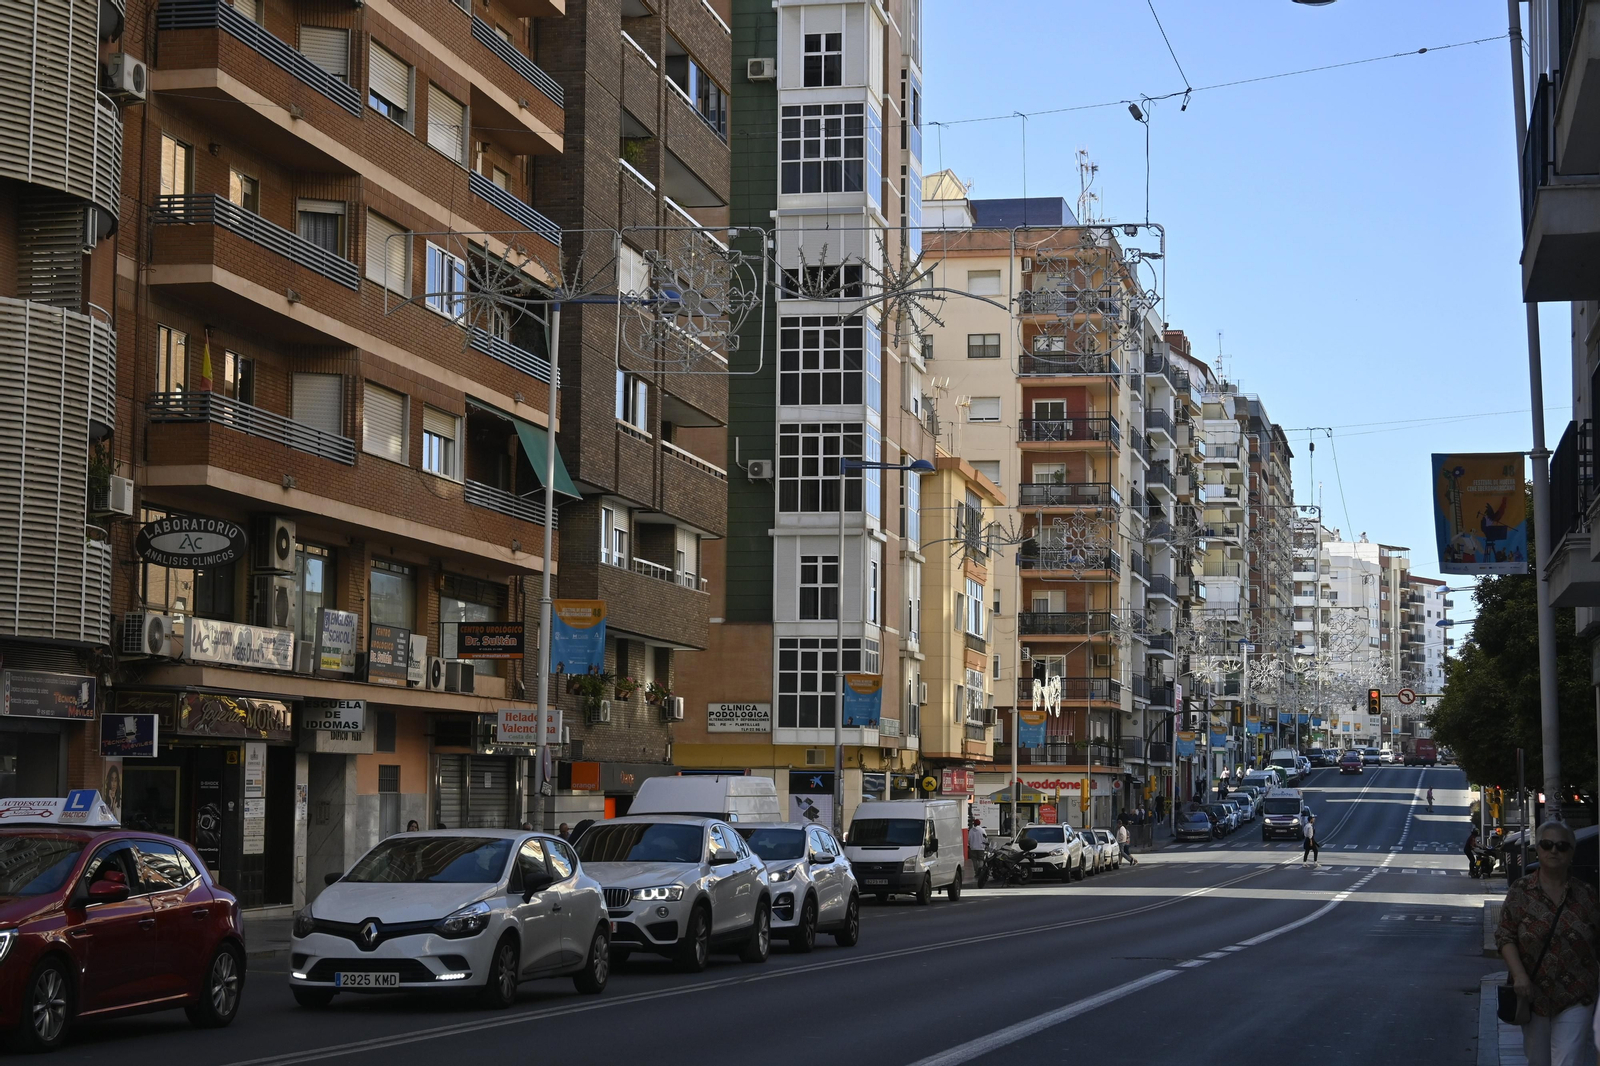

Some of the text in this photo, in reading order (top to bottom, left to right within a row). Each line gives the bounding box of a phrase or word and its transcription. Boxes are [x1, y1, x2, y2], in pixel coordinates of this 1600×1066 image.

[1502, 465, 1514, 477] 48
[143, 519, 238, 539] LABORATORIO
[145, 549, 234, 566] ANALISIS CLINICOS
[330, 613, 353, 627] ENGLISH
[328, 629, 351, 644] SCHOOL
[465, 635, 518, 646] Dr. Sultán
[305, 700, 362, 709] ESCUELA
[246, 705, 291, 731] MORAL
[325, 711, 341, 719] DE
[505, 712, 553, 722] Heladea
[306, 721, 359, 729] IDIOMAS
[502, 724, 556, 734] Valencina
[1027, 779, 1082, 790] vodafone
[71, 793, 84, 809] L
[343, 974, 397, 986] 2925 KMD
